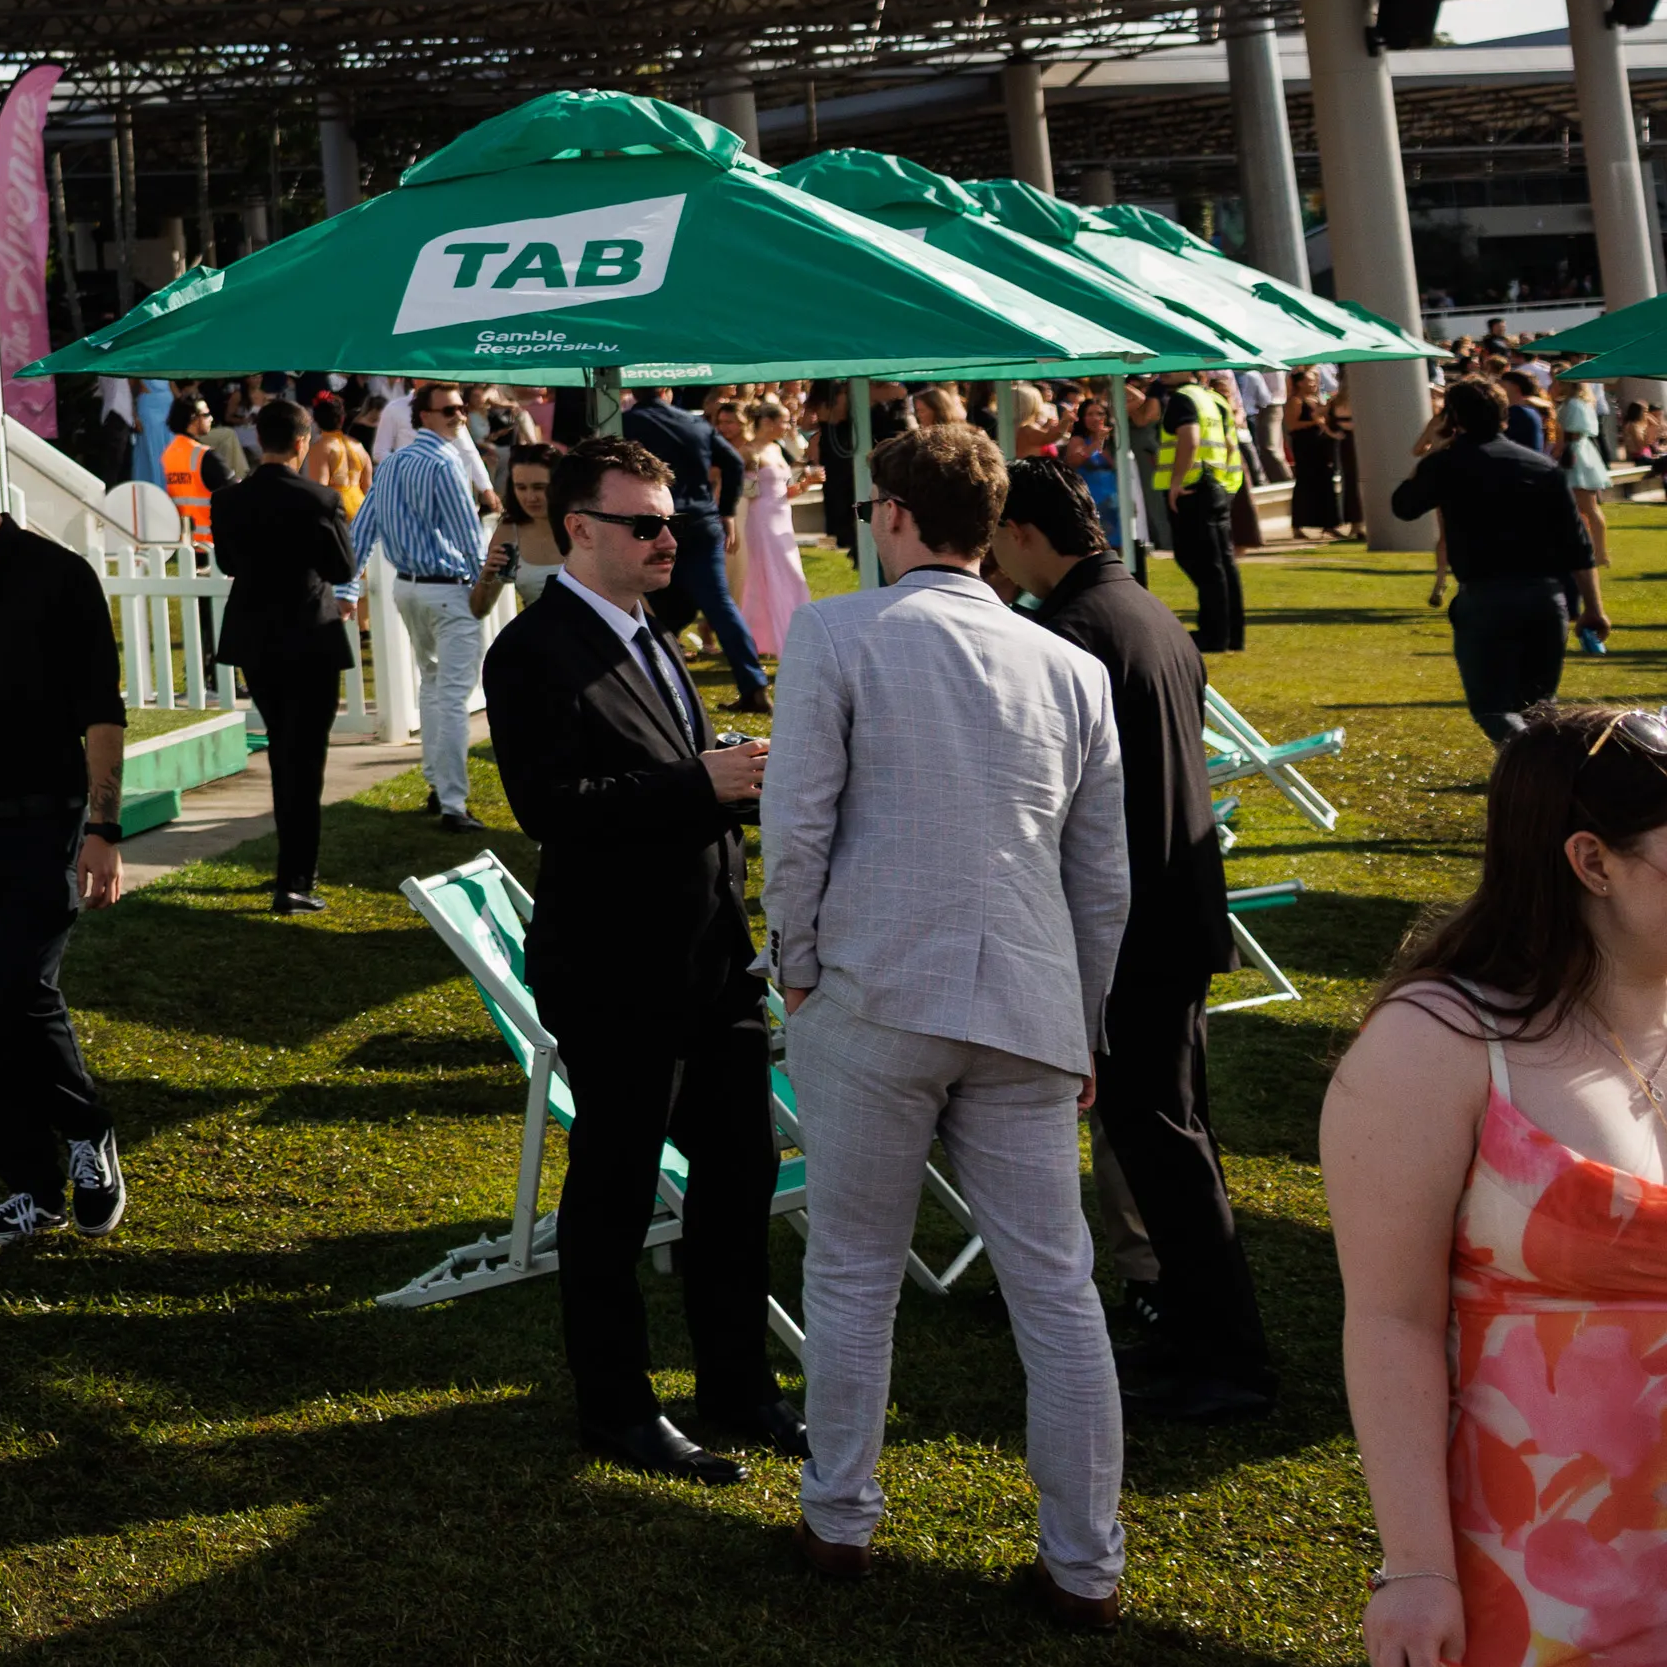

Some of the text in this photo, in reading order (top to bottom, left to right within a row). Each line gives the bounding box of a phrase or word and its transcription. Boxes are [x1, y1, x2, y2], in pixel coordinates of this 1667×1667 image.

[443, 238, 644, 289] TAB
[477, 330, 567, 344] Gamble
[474, 341, 620, 356] Responsibly.
